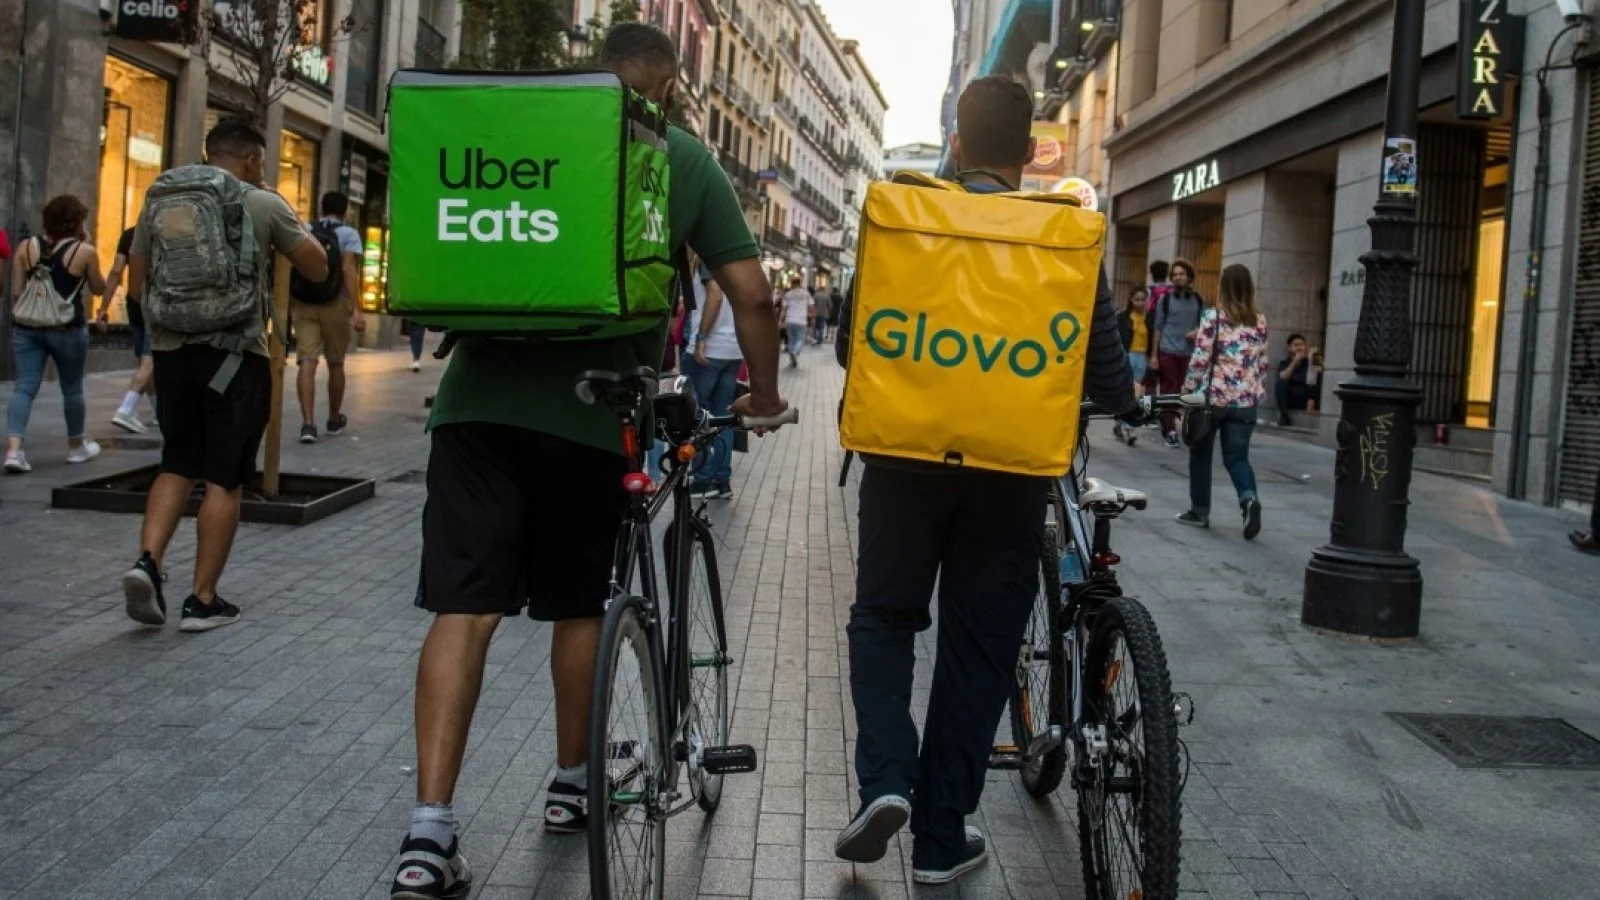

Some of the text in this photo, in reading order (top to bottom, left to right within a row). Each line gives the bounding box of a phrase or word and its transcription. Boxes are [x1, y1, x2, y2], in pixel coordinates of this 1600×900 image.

[123, 0, 178, 18] celio
[1472, 0, 1500, 114] ZARA
[440, 147, 560, 190] Uber
[1172, 159, 1220, 201] ZARA
[438, 198, 559, 242] Eats
[1340, 268, 1366, 286] ZAR
